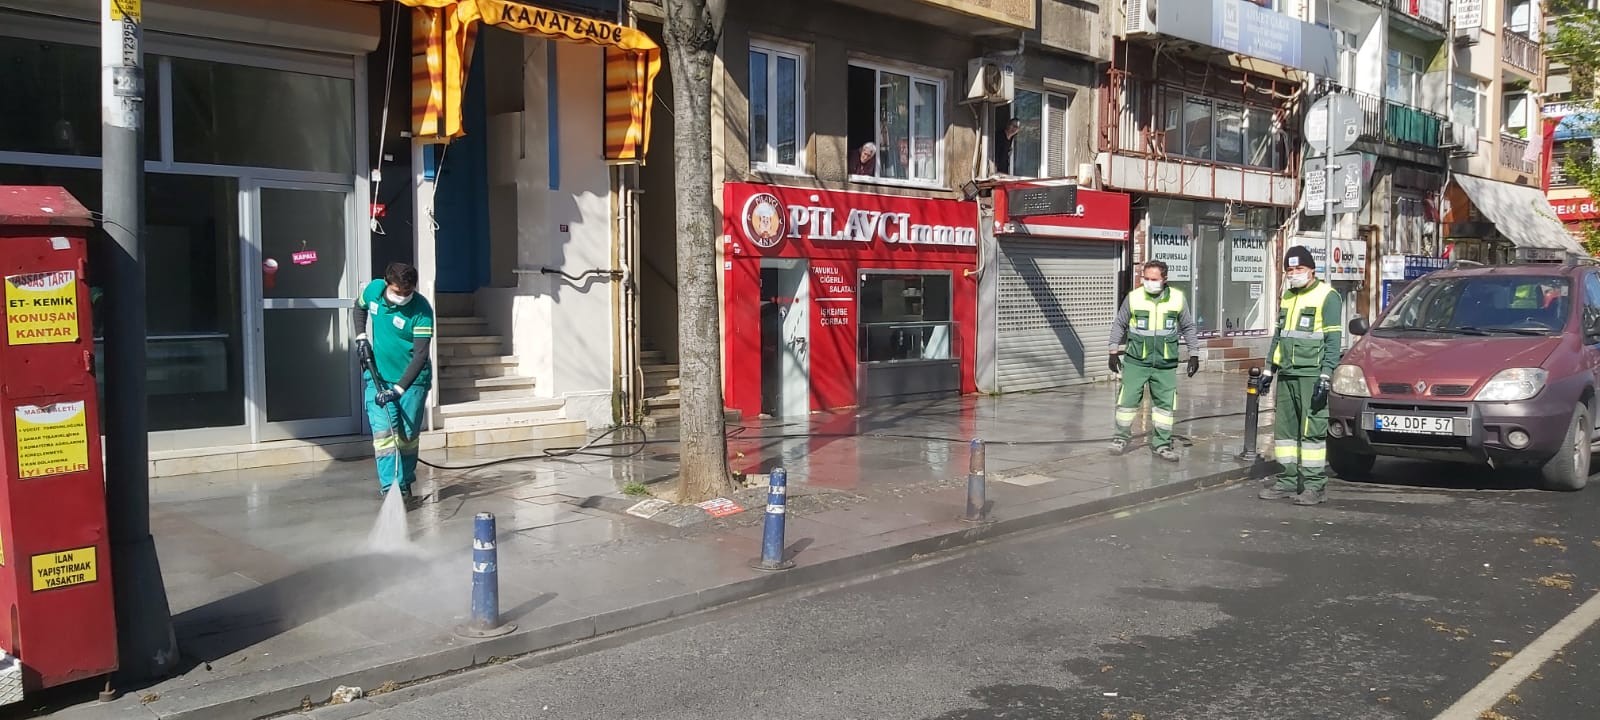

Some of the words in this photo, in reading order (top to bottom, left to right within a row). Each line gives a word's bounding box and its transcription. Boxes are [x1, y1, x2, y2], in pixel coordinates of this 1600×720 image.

[501, 4, 622, 42] KANATZADE
[1153, 231, 1189, 247] KİRALIK
[1233, 236, 1264, 249] KİRALIK
[33, 296, 73, 307] KEMİK
[9, 312, 76, 324] KONUŞAN
[16, 327, 71, 339] KANTAR
[1383, 415, 1398, 428] 34
[1404, 417, 1427, 430] DDF
[1435, 418, 1451, 431] 57
[21, 466, 40, 477] İYİ
[45, 463, 86, 473] GELİR
[55, 553, 74, 564] İLAN
[38, 562, 91, 577] YAPIŞTIRMAK
[45, 574, 85, 587] YASAKTIR
